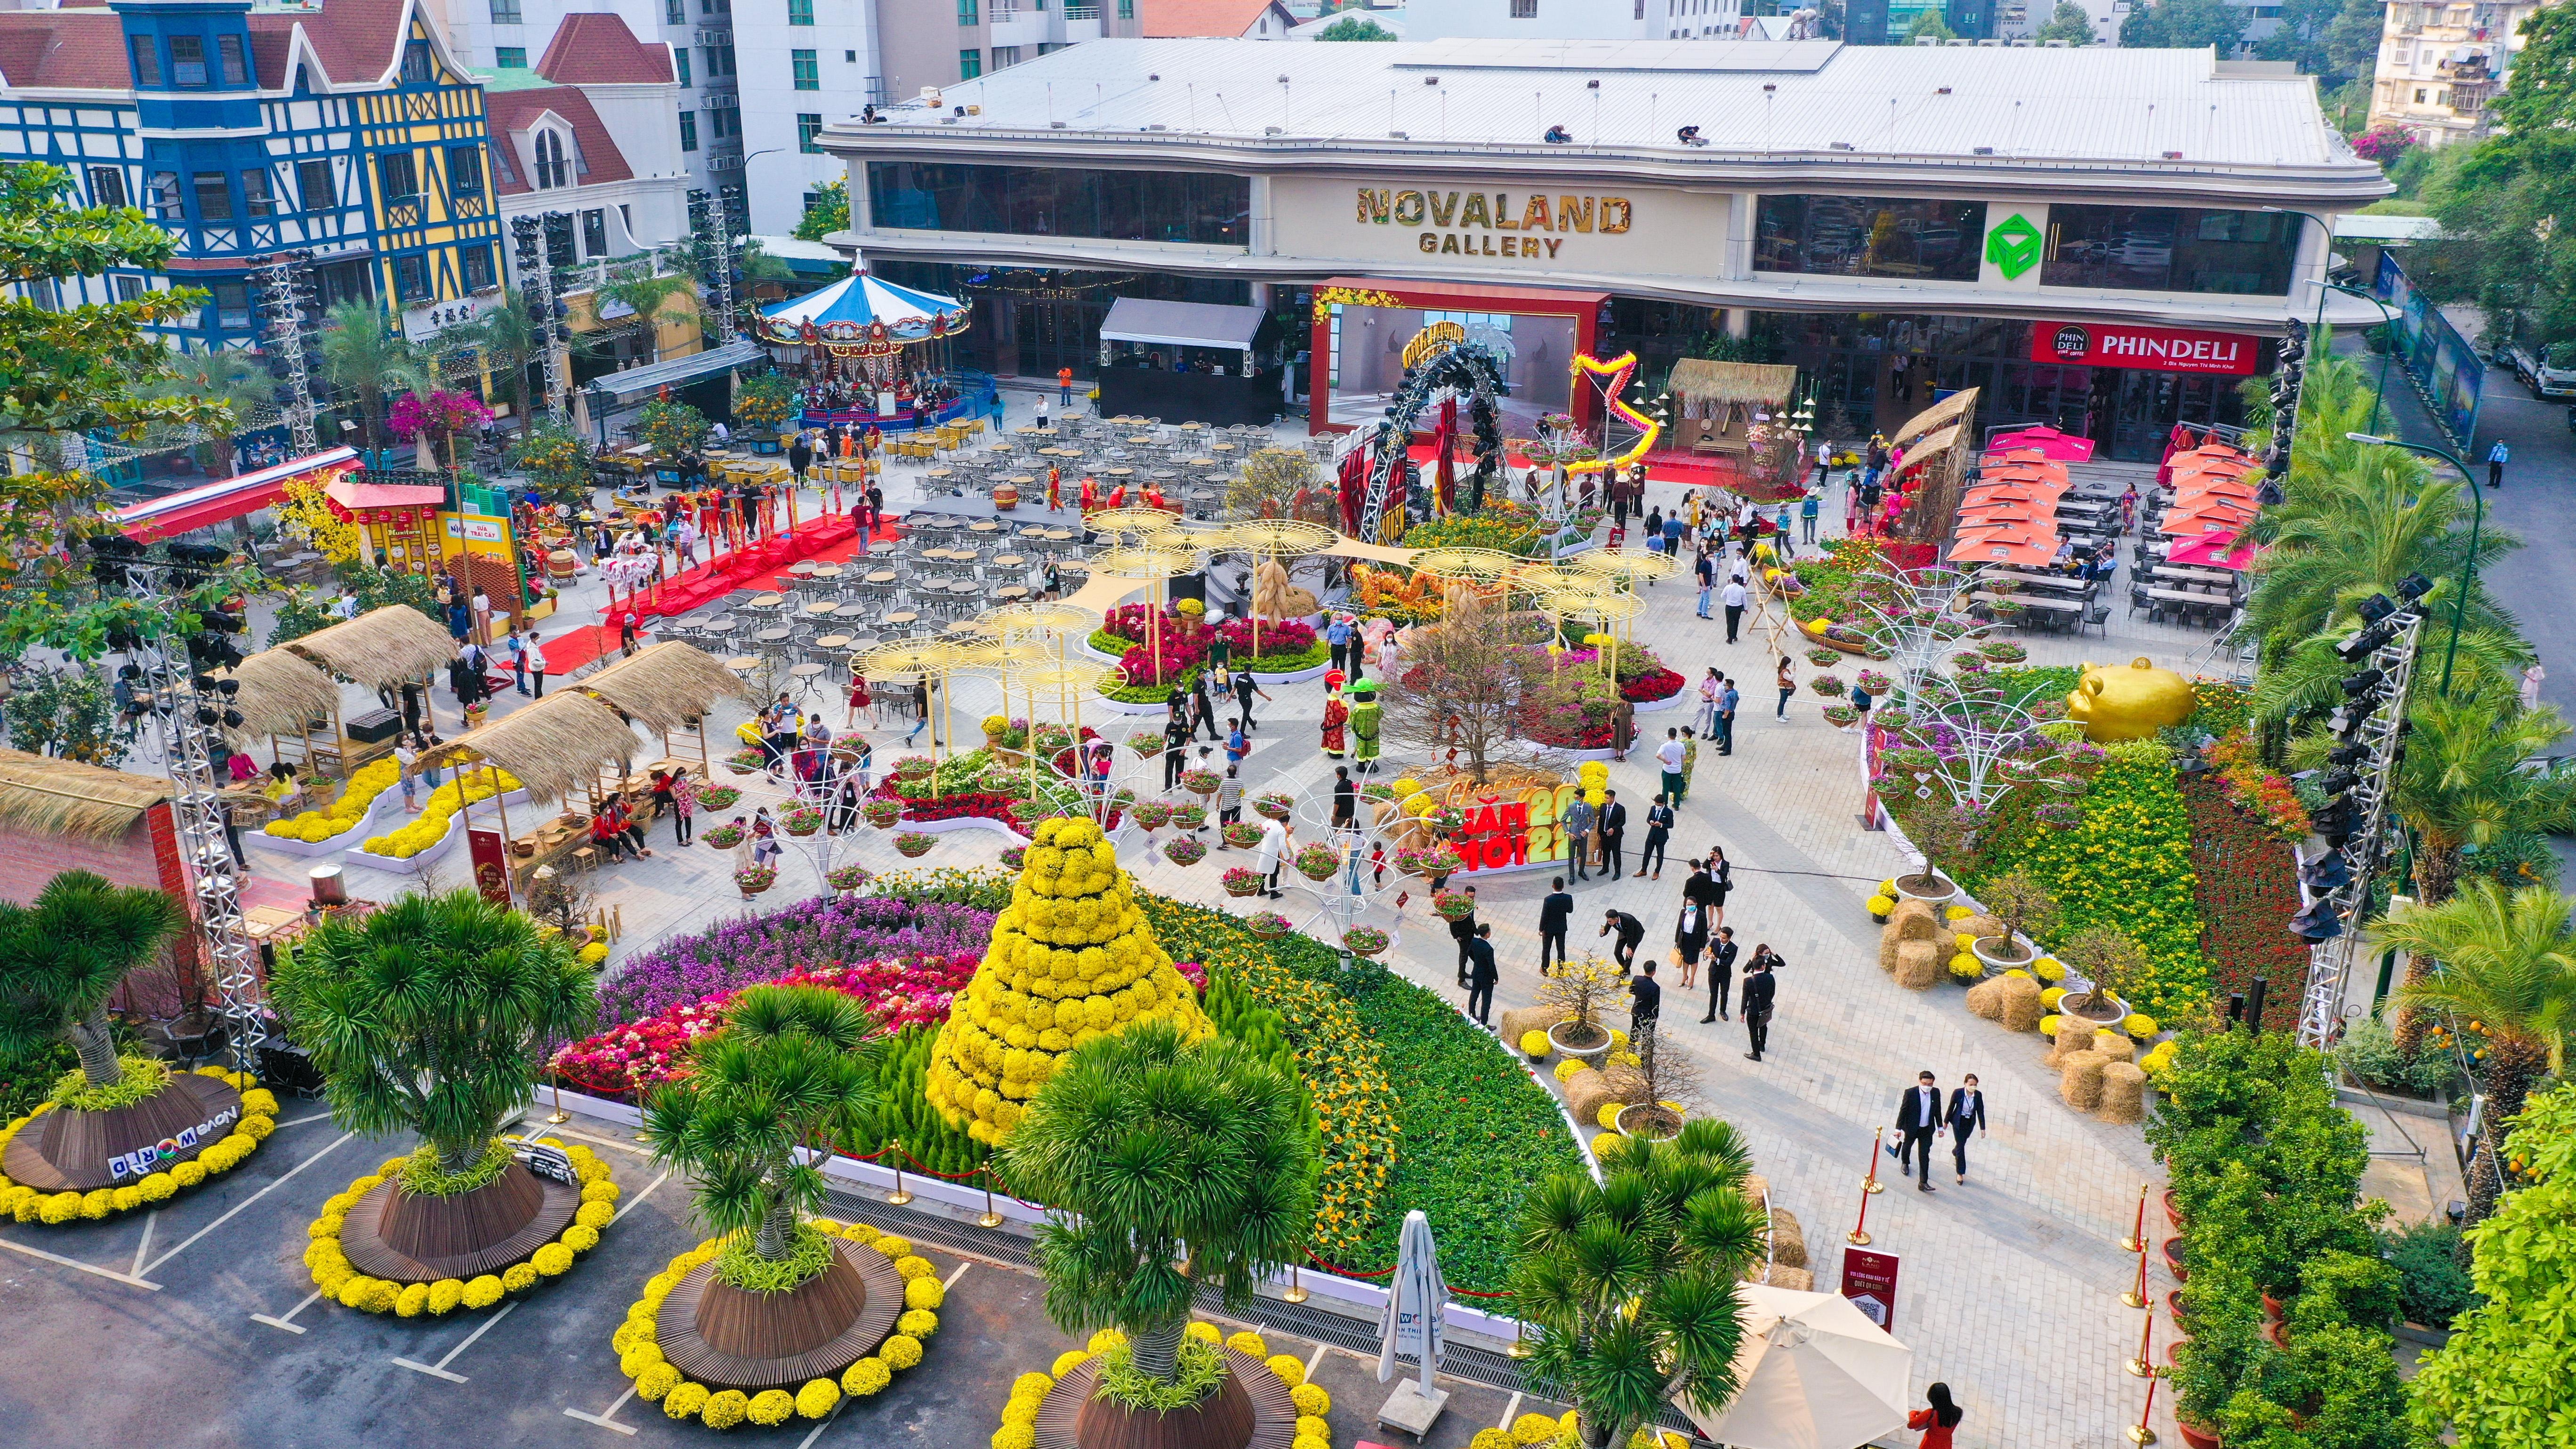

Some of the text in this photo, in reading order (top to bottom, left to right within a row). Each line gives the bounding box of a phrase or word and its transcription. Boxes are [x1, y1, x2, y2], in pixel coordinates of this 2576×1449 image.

[1357, 187, 1632, 234] NOVALAND
[1418, 232, 1563, 259] GALLERY
[2058, 341, 2083, 350] DELI
[2059, 333, 2085, 342] PHIN
[2102, 335, 2238, 361] PHINDELI
